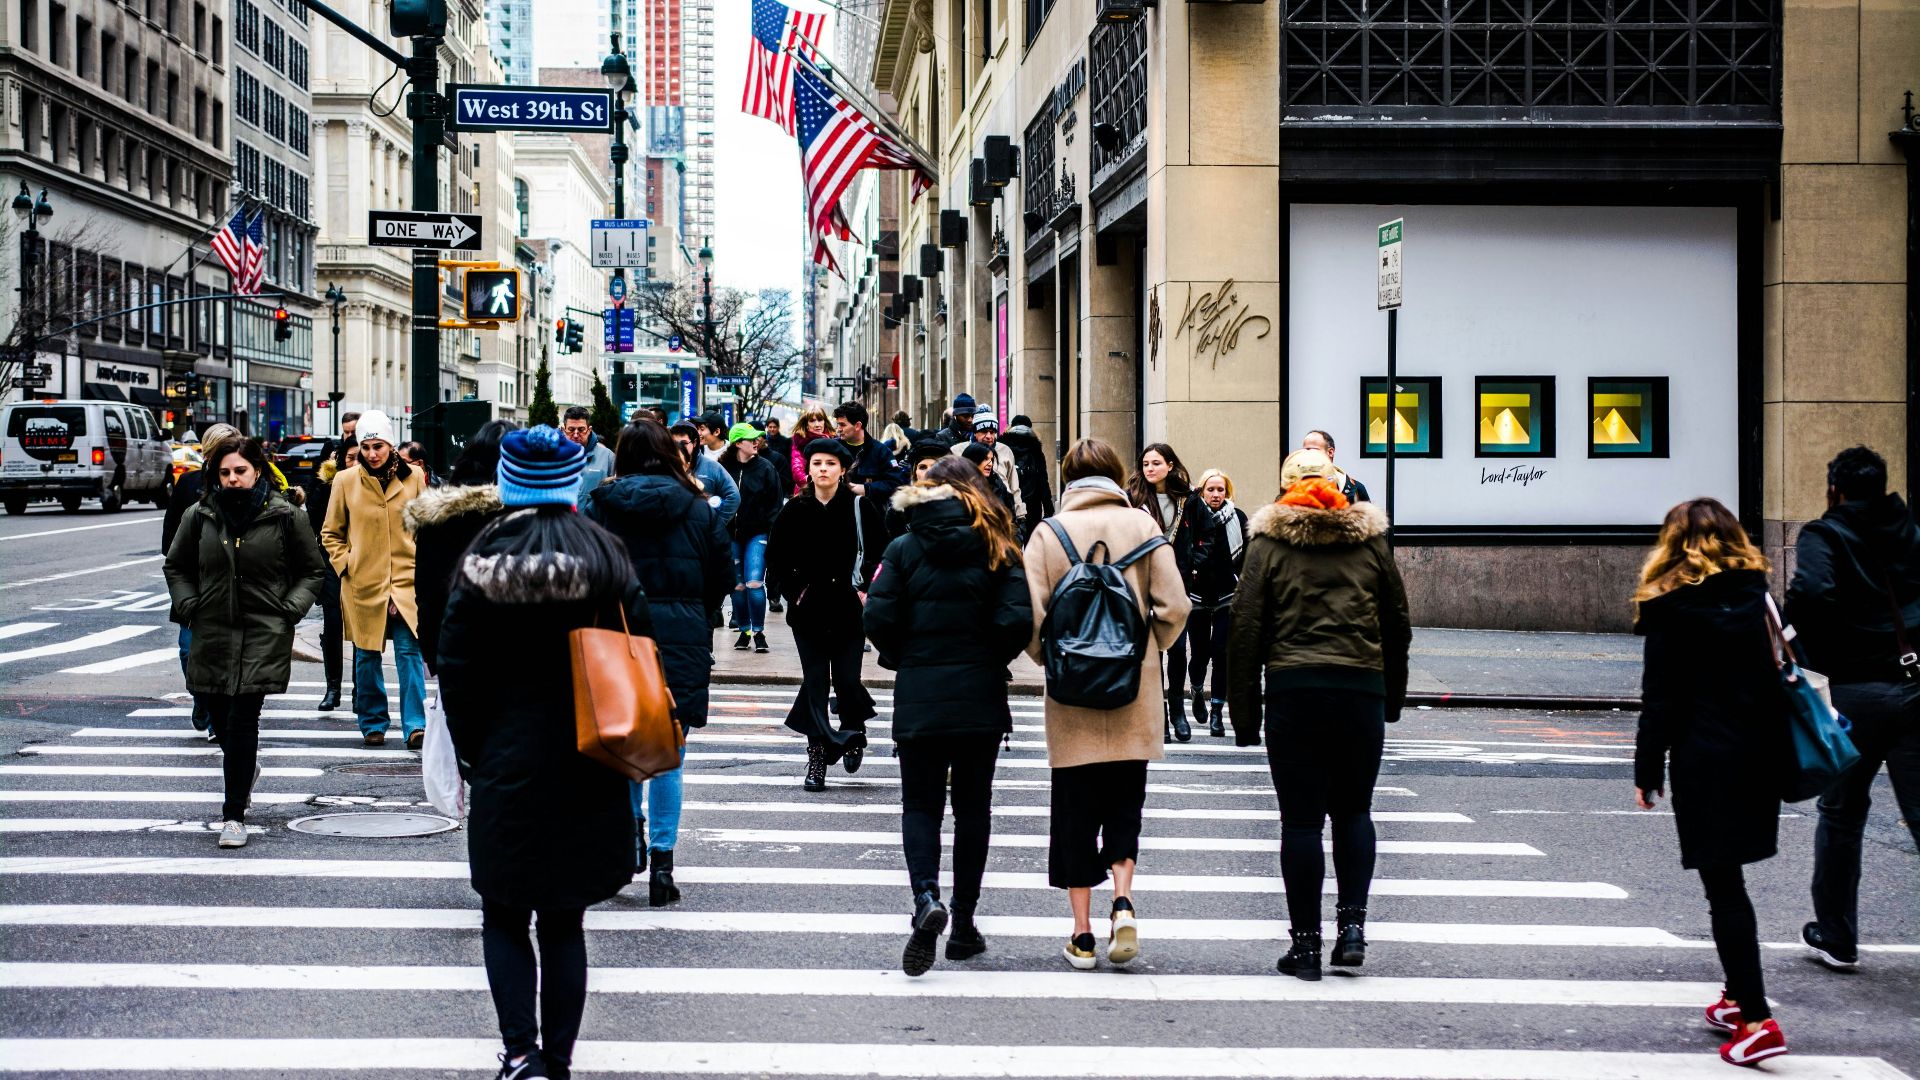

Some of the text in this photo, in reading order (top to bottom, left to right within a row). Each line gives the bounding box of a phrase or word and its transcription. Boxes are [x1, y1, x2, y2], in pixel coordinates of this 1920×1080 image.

[462, 98, 604, 121] West 39th St
[385, 222, 466, 239] ONE WAY
[683, 387, 692, 417] Avenue
[25, 436, 67, 445] FILMS
[1481, 466, 1506, 484] Lord
[1509, 464, 1548, 487] Taylor
